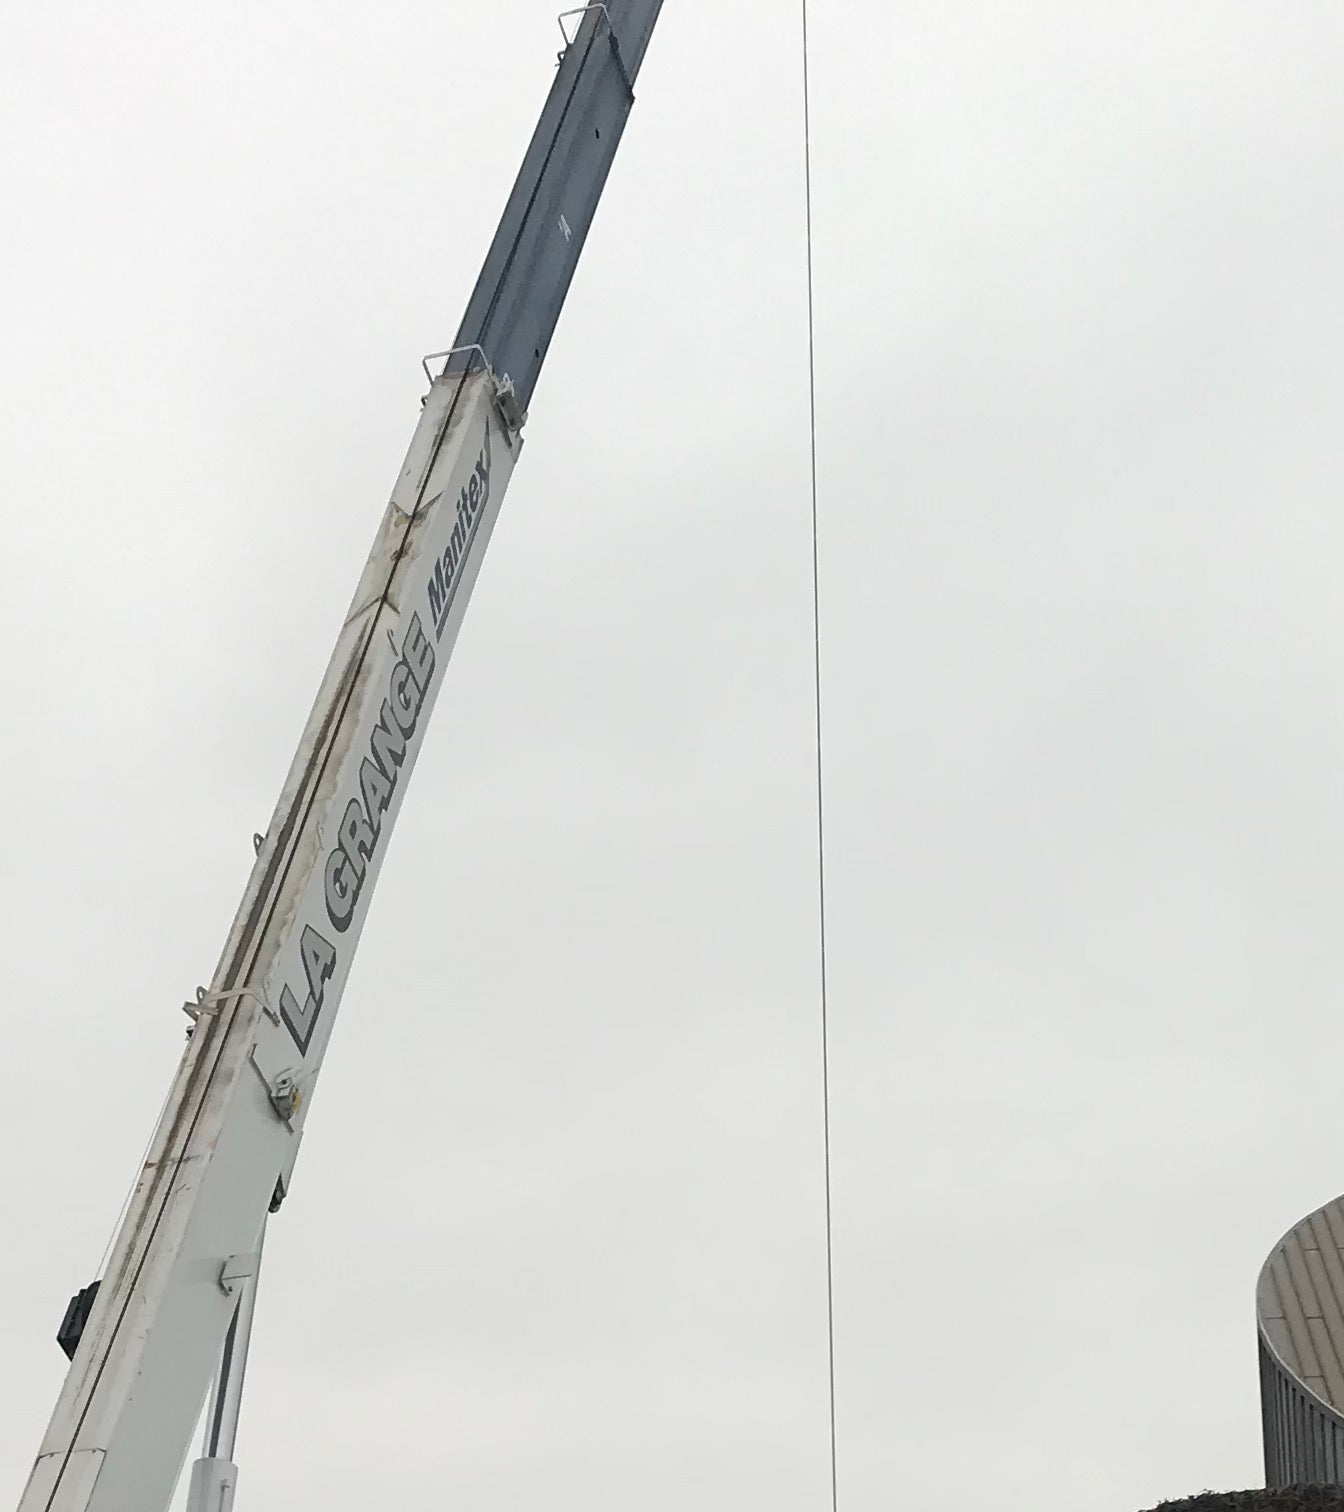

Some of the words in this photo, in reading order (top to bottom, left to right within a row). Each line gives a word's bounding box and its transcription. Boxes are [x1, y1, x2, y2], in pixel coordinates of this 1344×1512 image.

[427, 448, 488, 627] Manitex
[279, 924, 337, 1059] LA
[324, 610, 435, 933] GRANGE
